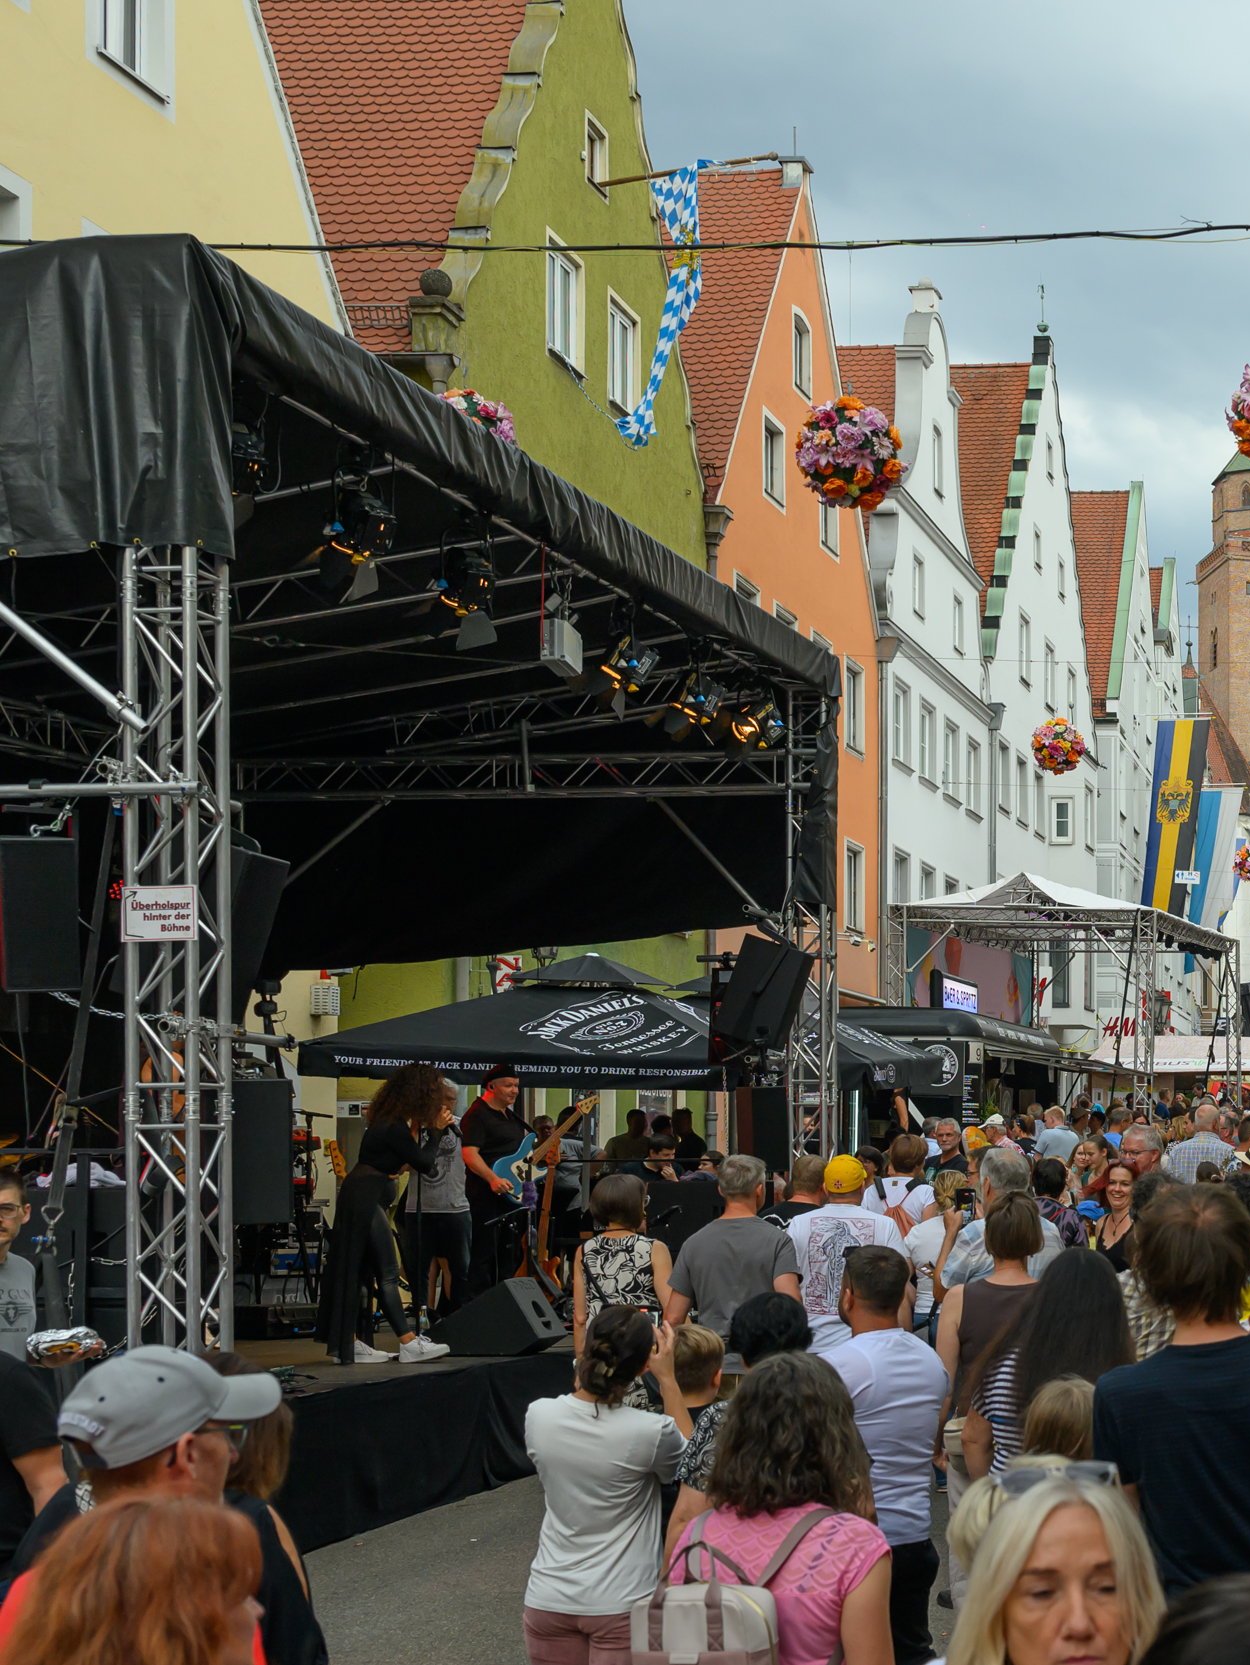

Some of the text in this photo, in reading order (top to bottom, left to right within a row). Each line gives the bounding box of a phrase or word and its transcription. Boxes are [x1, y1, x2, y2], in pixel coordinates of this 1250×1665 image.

[131, 899, 191, 911] Überholspur
[143, 911, 191, 921] hinter der
[160, 923, 191, 932] Bühne
[527, 1014, 574, 1040] JACK
[597, 1019, 676, 1051] Tennessee
[616, 1025, 690, 1055] WHISKEY
[975, 1047, 982, 1061] 9
[333, 1054, 364, 1065] YOUR
[433, 1061, 461, 1070] JACK
[514, 1064, 557, 1073] REMIND
[559, 1065, 582, 1074] YOU
[584, 1066, 598, 1075] TO
[601, 1066, 636, 1076] DRINK
[638, 1067, 711, 1077] RESPONSIBLY
[8, 1288, 31, 1300] GUN
